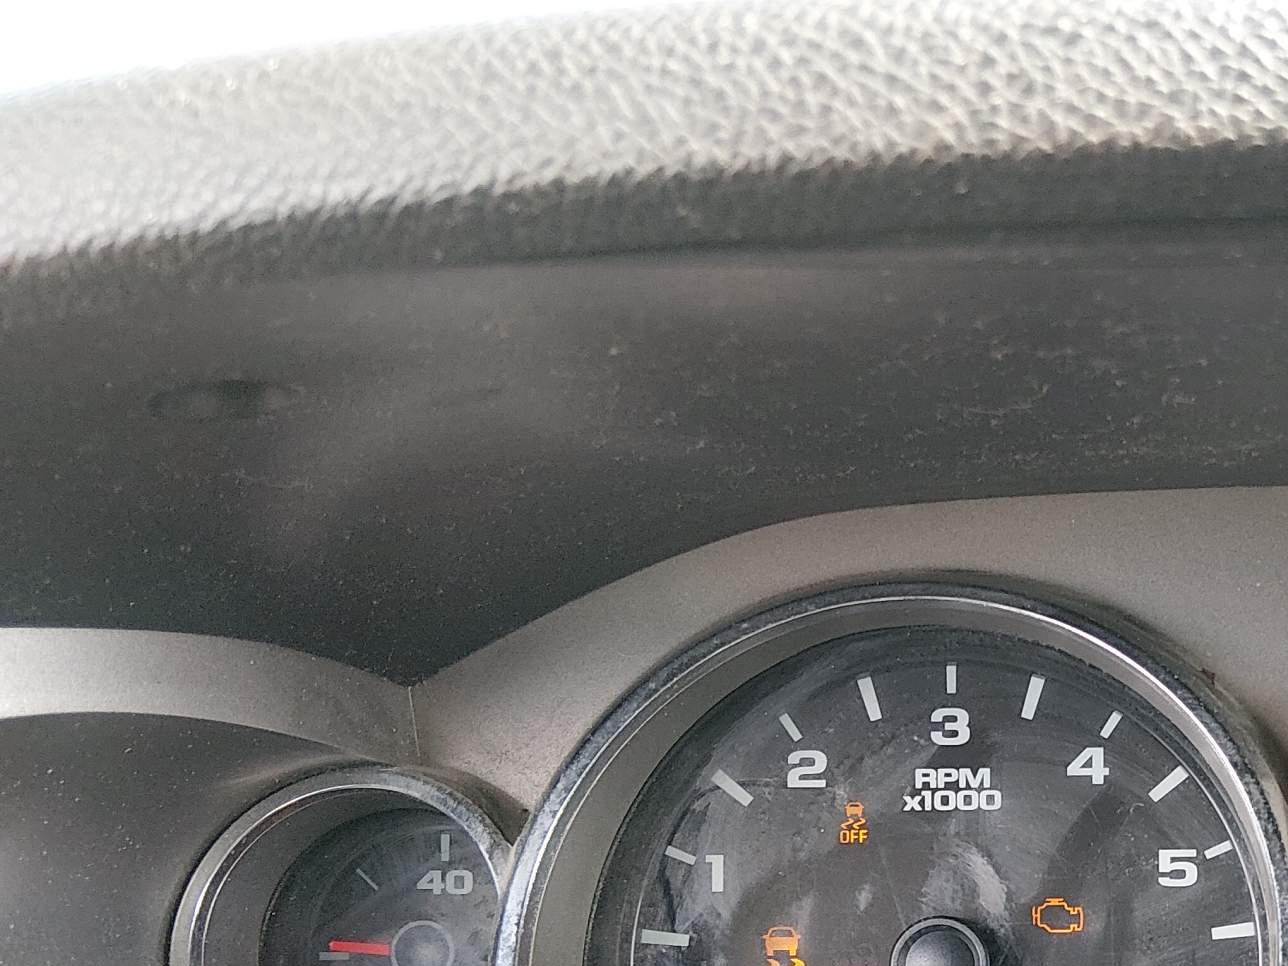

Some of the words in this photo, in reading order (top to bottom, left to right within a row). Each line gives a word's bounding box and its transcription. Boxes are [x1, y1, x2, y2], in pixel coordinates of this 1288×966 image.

[931, 707, 970, 746] 3
[787, 750, 828, 788] 2
[914, 769, 991, 789] RPM
[1066, 747, 1109, 785] 4
[903, 790, 1002, 811] x1000
[839, 829, 868, 844] OFF
[417, 869, 474, 895] 40
[705, 855, 724, 892] 1
[1158, 850, 1199, 887] 5
